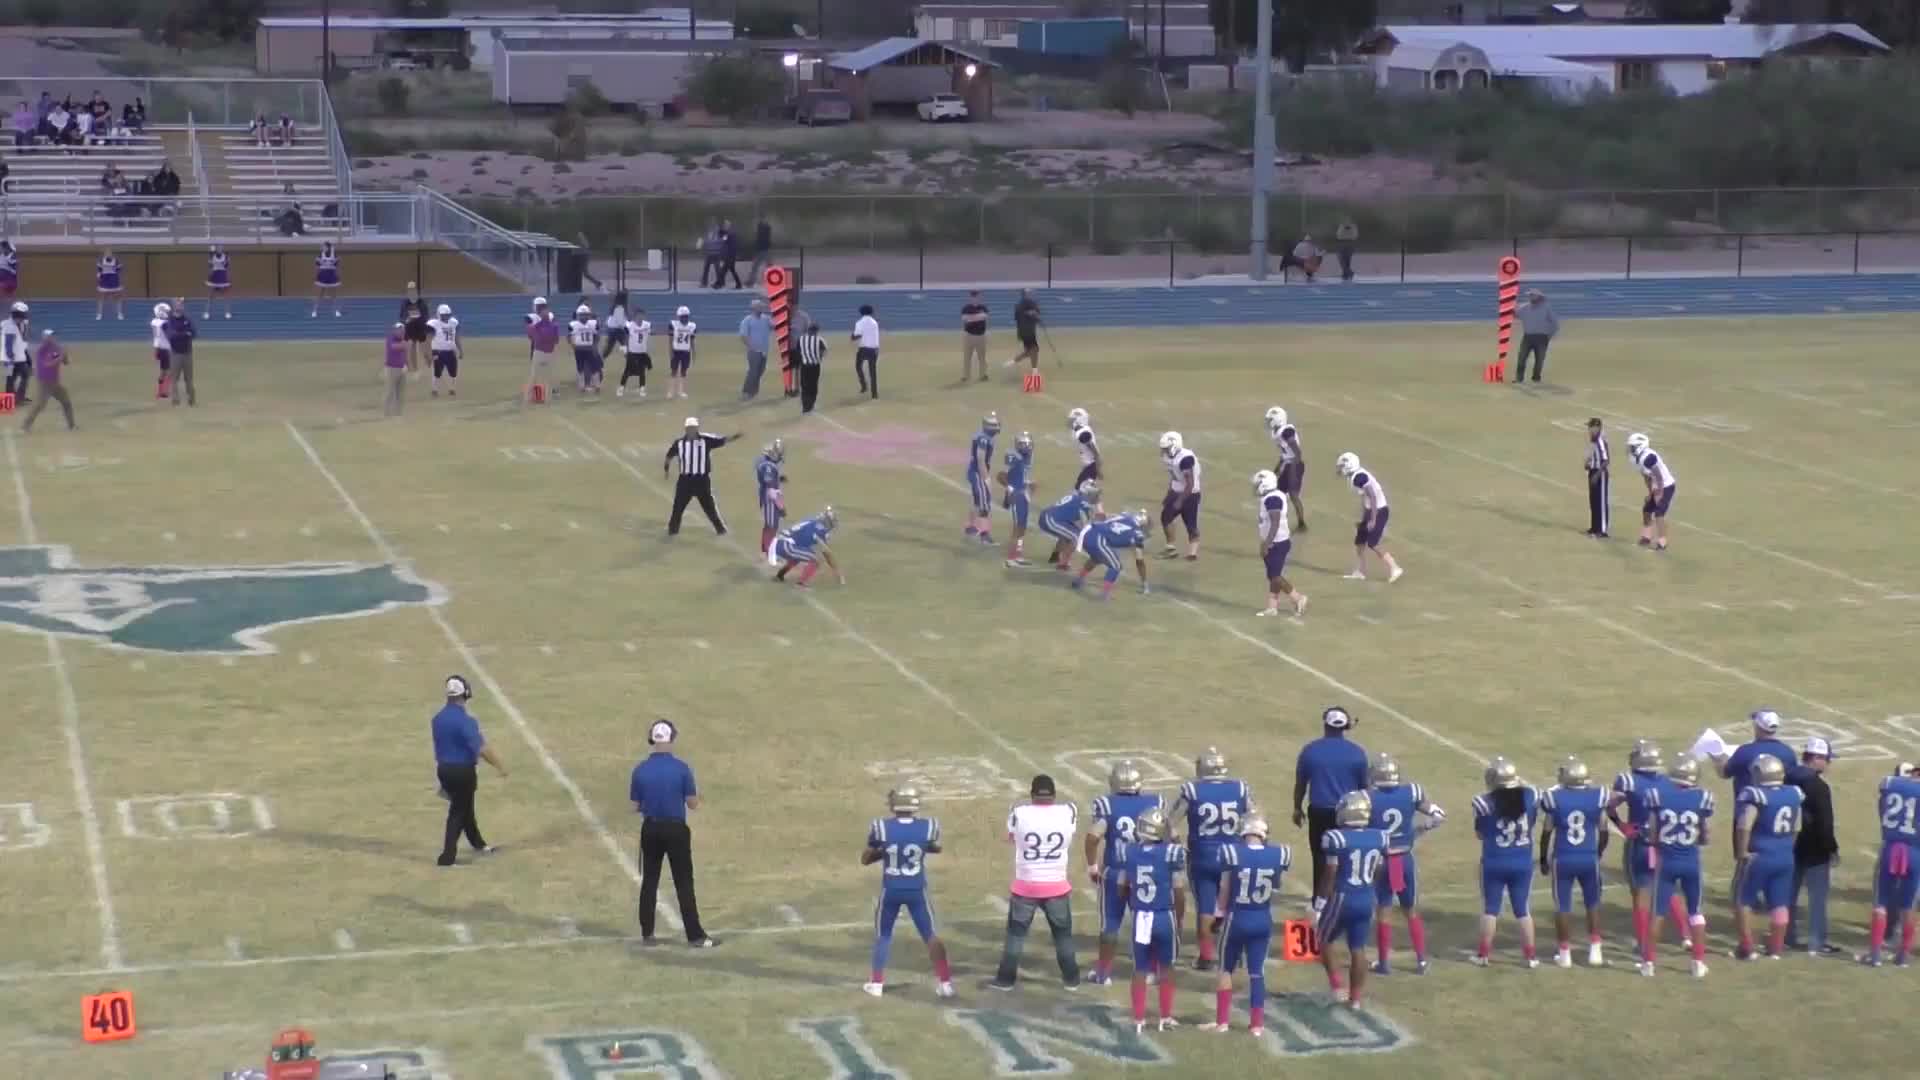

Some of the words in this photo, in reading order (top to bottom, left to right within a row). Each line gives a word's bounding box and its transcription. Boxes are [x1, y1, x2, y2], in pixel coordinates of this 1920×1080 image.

[1198, 801, 1240, 837] 25
[1382, 808, 1402, 838] 2
[1567, 810, 1586, 845] 8
[1659, 808, 1699, 845] 23
[1882, 792, 1916, 834] 21
[885, 843, 922, 877] 13
[1023, 832, 1064, 861] 32
[1136, 865, 1156, 904] 5
[1236, 867, 1275, 904] 15
[1348, 848, 1382, 886] 10
[90, 997, 130, 1035] 40
